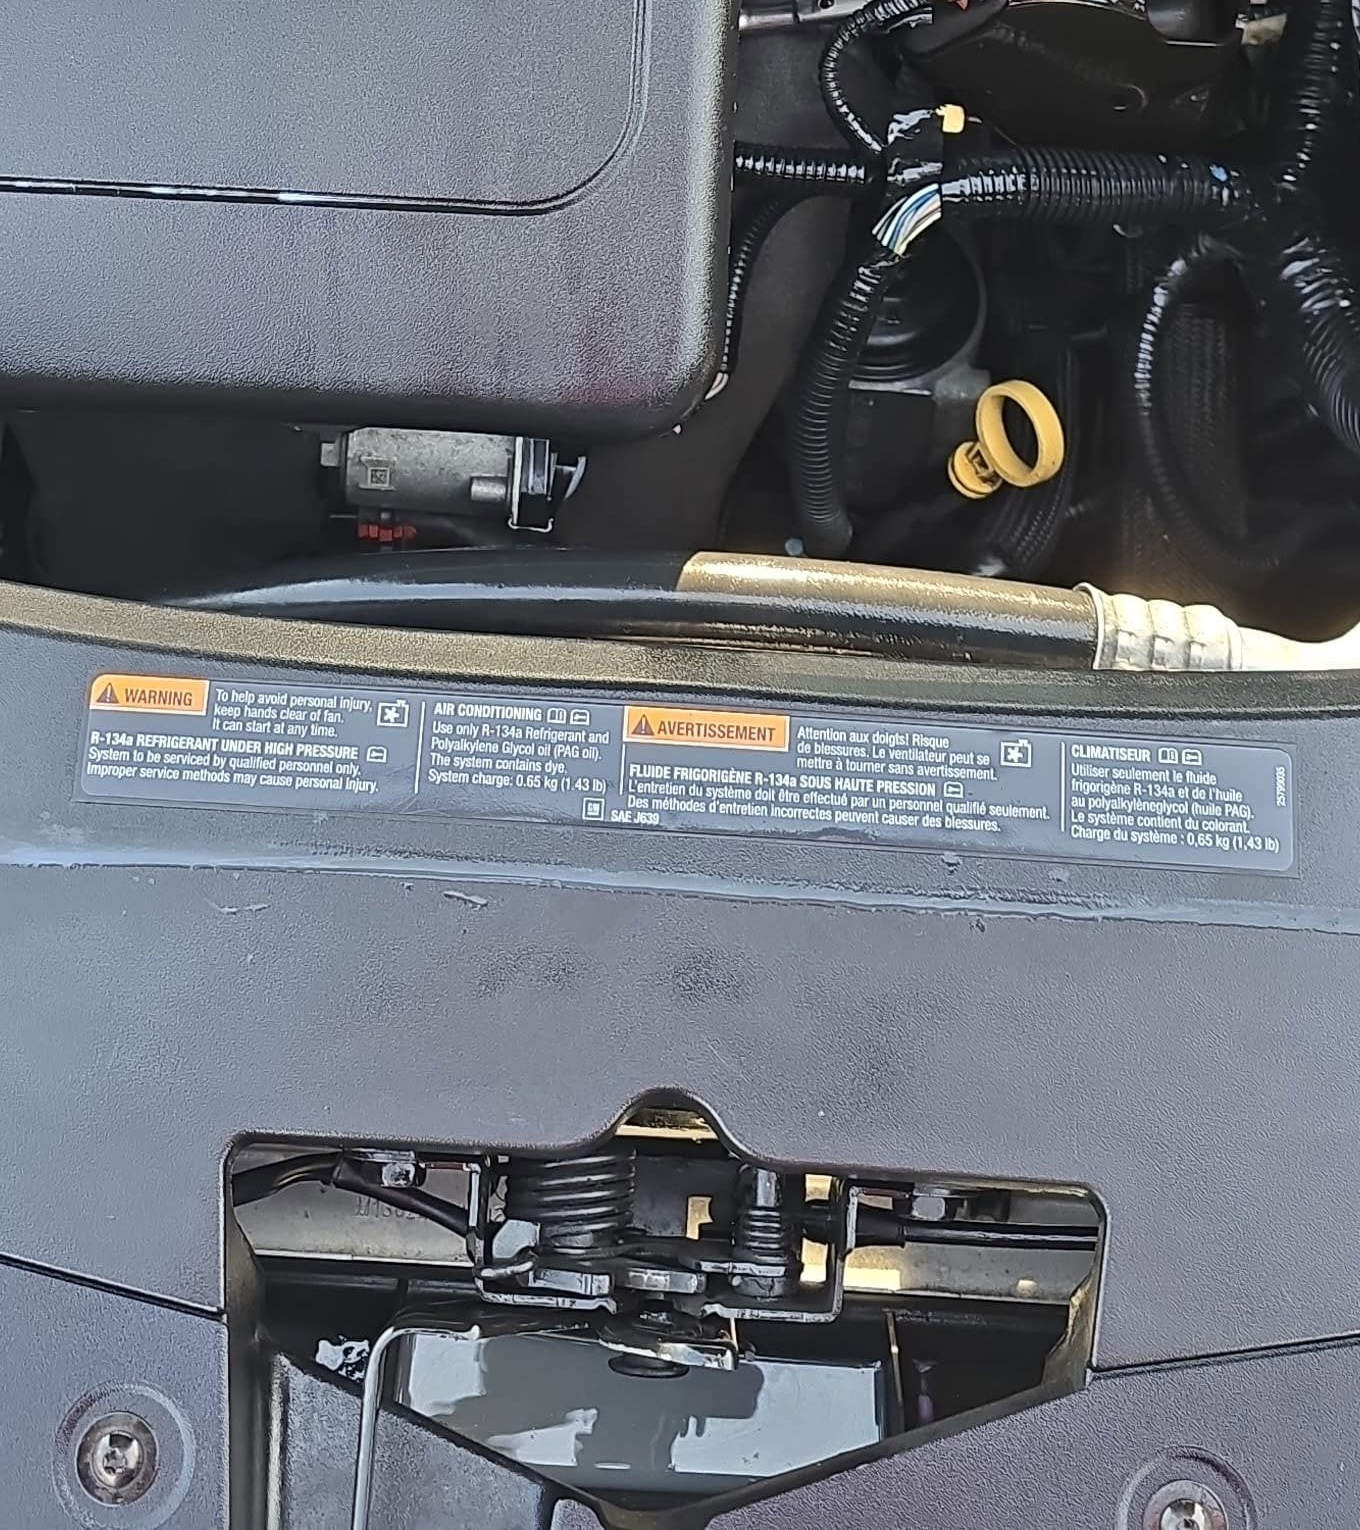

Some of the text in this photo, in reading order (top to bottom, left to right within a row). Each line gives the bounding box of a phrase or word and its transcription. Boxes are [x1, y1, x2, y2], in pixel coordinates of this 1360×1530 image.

[124, 688, 192, 706] WARNING
[216, 689, 372, 712] To help avoid personal injury,
[214, 704, 344, 723] keep hands clear of fan.
[434, 703, 542, 720] AIR CONDITIONING
[212, 720, 338, 738] It can start at any time.
[433, 721, 609, 743] Use only R-134a Refrigerant and
[657, 721, 776, 742] AVERTISSEMENT
[797, 726, 949, 748] Attention aux doigts! Risque
[91, 731, 358, 759] R-134a REFRIGERANT UNDER HIGH PRESSURE
[431, 738, 601, 761] Polyalkylene Glycol oil (PAG oil).
[797, 742, 989, 765] de blessures. Le ventilateur peut se
[1072, 744, 1151, 762] CLIMATISEUR
[88, 747, 360, 776] System to be serviced by qualified personnel only.
[430, 753, 567, 775] The system contains dye.
[797, 757, 832, 770] mettre
[846, 760, 885, 773] tourner
[888, 763, 913, 775] sans
[917, 765, 997, 781] avertissement.
[87, 762, 137, 779] Improper
[139, 766, 179, 779] service
[183, 767, 230, 783] methods
[233, 772, 257, 786] may
[260, 773, 292, 786] cause
[295, 773, 342, 790] personal
[428, 769, 606, 795] System charge: 0.65 kg (1.43 lb)
[629, 764, 936, 797] FLUIDE FRIGORIGÈNE R-134a SOUS HAUTE PRESSION
[1072, 763, 1216, 785] Utiliser seulement le fluide
[629, 780, 1050, 819] L'entretien du système doit être effectué par un personnel qualifié seulement.
[1071, 779, 1242, 802] frigorigène R-134a et de l'huile
[611, 810, 659, 824] SAE J639
[628, 795, 1001, 831] Des méthodes d'entretien incorrectes peuvent causer des blessures.
[1072, 797, 1085, 808] au
[1192, 802, 1222, 816] (huile
[1225, 804, 1254, 819] PAG).
[1072, 810, 1250, 834] Le système contient du colorant.
[1071, 825, 1110, 842] Charge
[1114, 828, 1128, 840] du
[1131, 828, 1177, 845] système
[1216, 835, 1229, 850] kg
[1265, 838, 1279, 853] lb)
